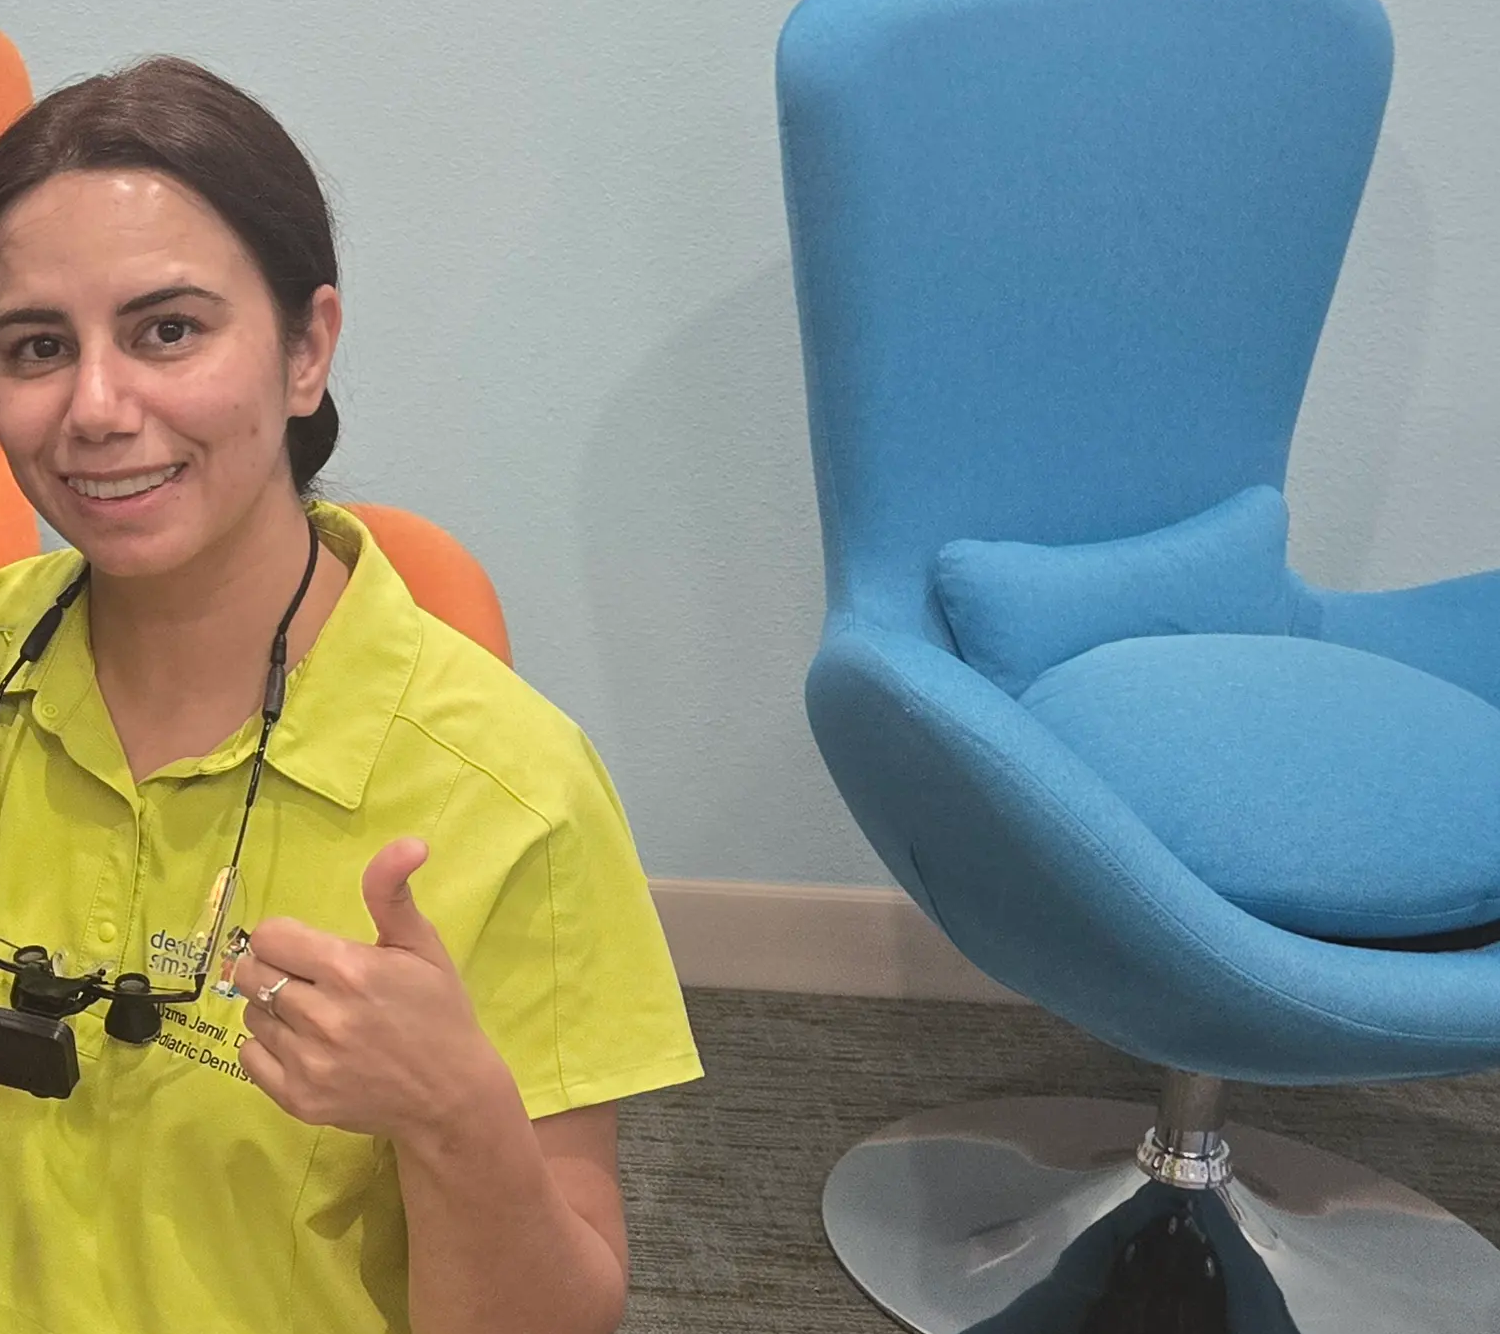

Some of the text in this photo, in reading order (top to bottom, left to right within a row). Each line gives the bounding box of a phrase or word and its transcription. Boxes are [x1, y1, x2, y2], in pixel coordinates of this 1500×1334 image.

[150, 929, 208, 962] denta
[189, 1016, 229, 1047] Jamil,
[152, 1031, 255, 1085] ediatric Dentis
